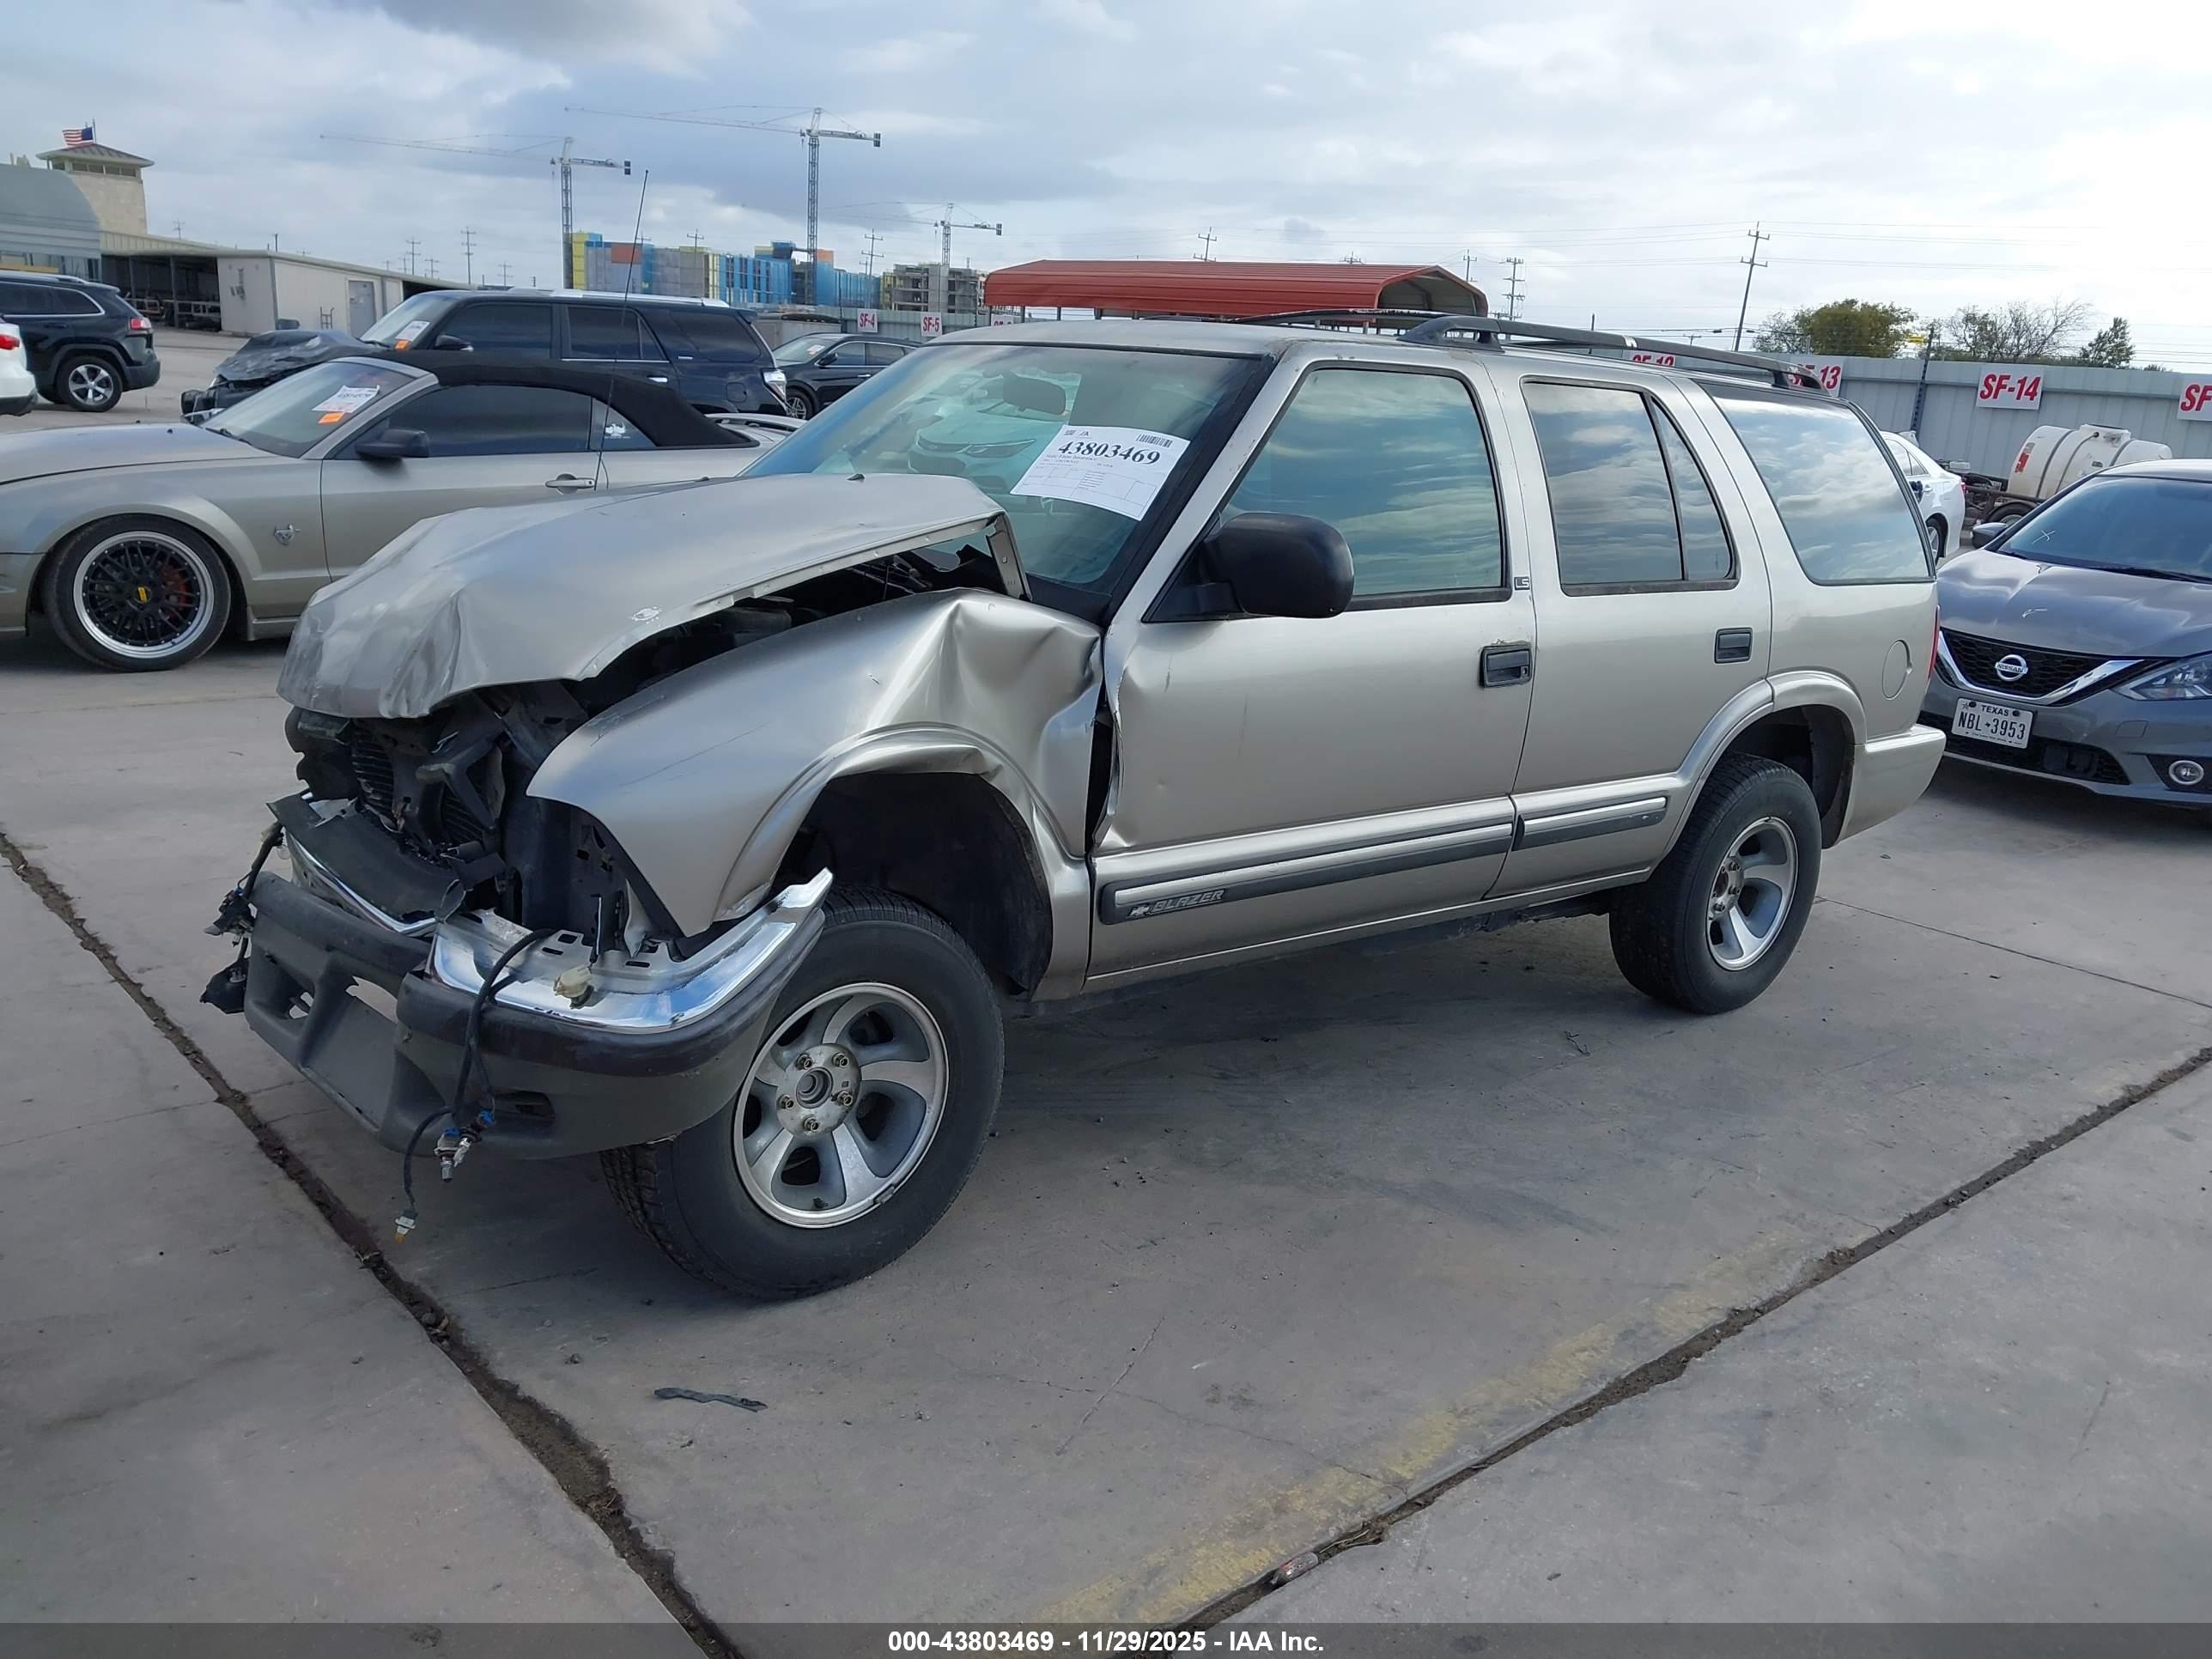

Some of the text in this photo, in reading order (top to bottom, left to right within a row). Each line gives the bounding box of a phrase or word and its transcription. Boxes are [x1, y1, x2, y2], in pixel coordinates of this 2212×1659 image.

[860, 313, 875, 327] SF-4
[923, 317, 939, 332] SF-5
[1979, 374, 2041, 401] SF-14
[1058, 441, 1161, 465] 43803469
[1996, 663, 2024, 674] NISSAN
[1981, 705, 2009, 716] TEXAS
[1151, 889, 1225, 912] BLAZER
